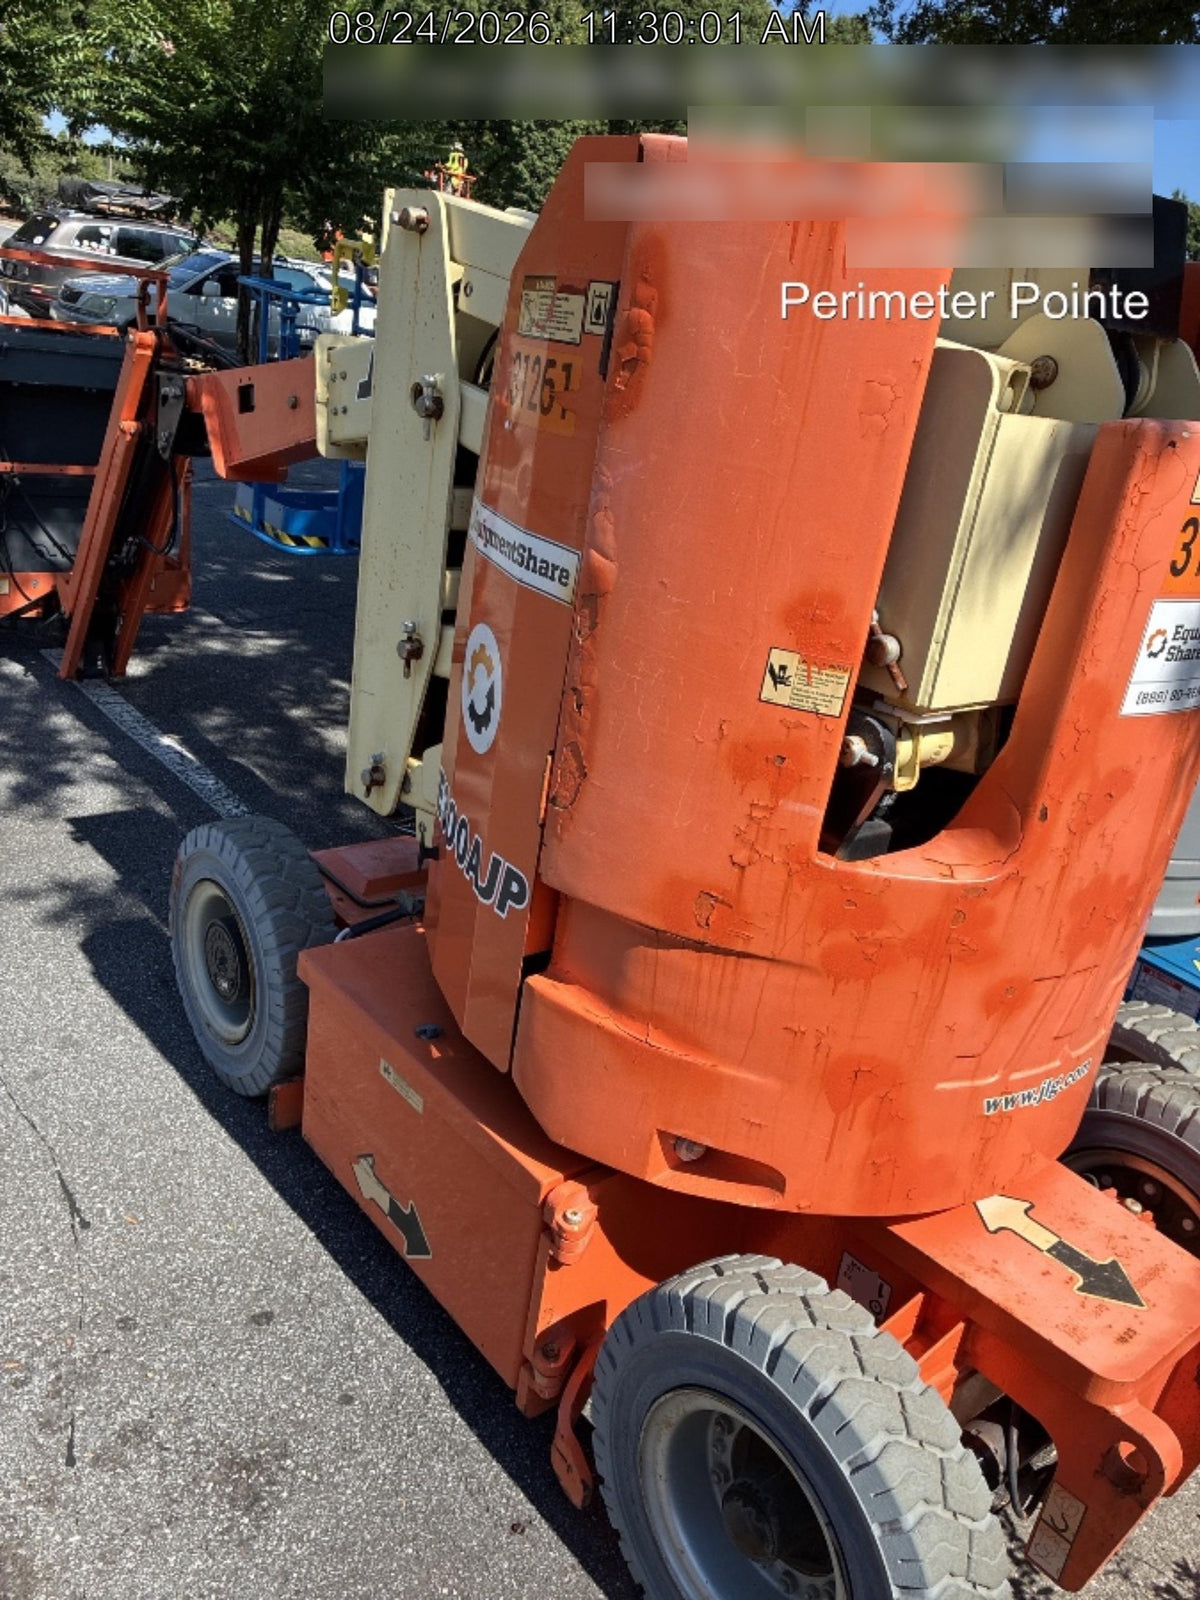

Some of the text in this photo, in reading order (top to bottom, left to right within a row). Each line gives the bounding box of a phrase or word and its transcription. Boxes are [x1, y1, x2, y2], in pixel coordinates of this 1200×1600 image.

[1170, 517, 1200, 577] 3
[1171, 624, 1200, 645] Equi
[984, 1058, 1093, 1115] www.jlg.com
